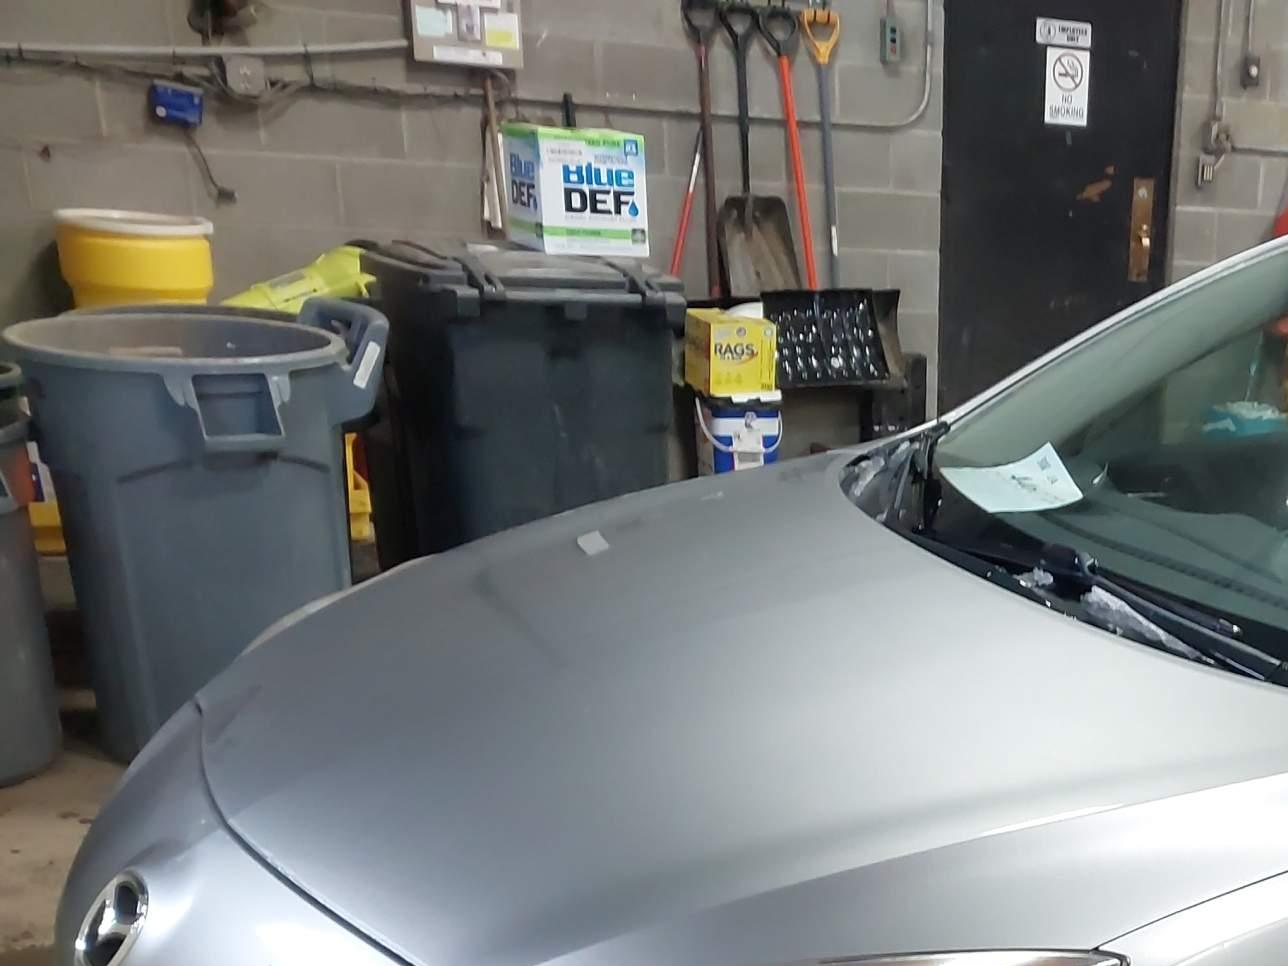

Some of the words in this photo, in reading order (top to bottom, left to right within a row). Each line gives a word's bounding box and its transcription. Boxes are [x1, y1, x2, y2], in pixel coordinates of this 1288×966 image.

[1061, 93, 1073, 105] NO
[1049, 103, 1084, 119] SMOKING
[562, 162, 635, 188] Blue
[511, 179, 536, 208] DEF
[564, 187, 635, 216] DEF
[714, 343, 755, 358] RAGS
